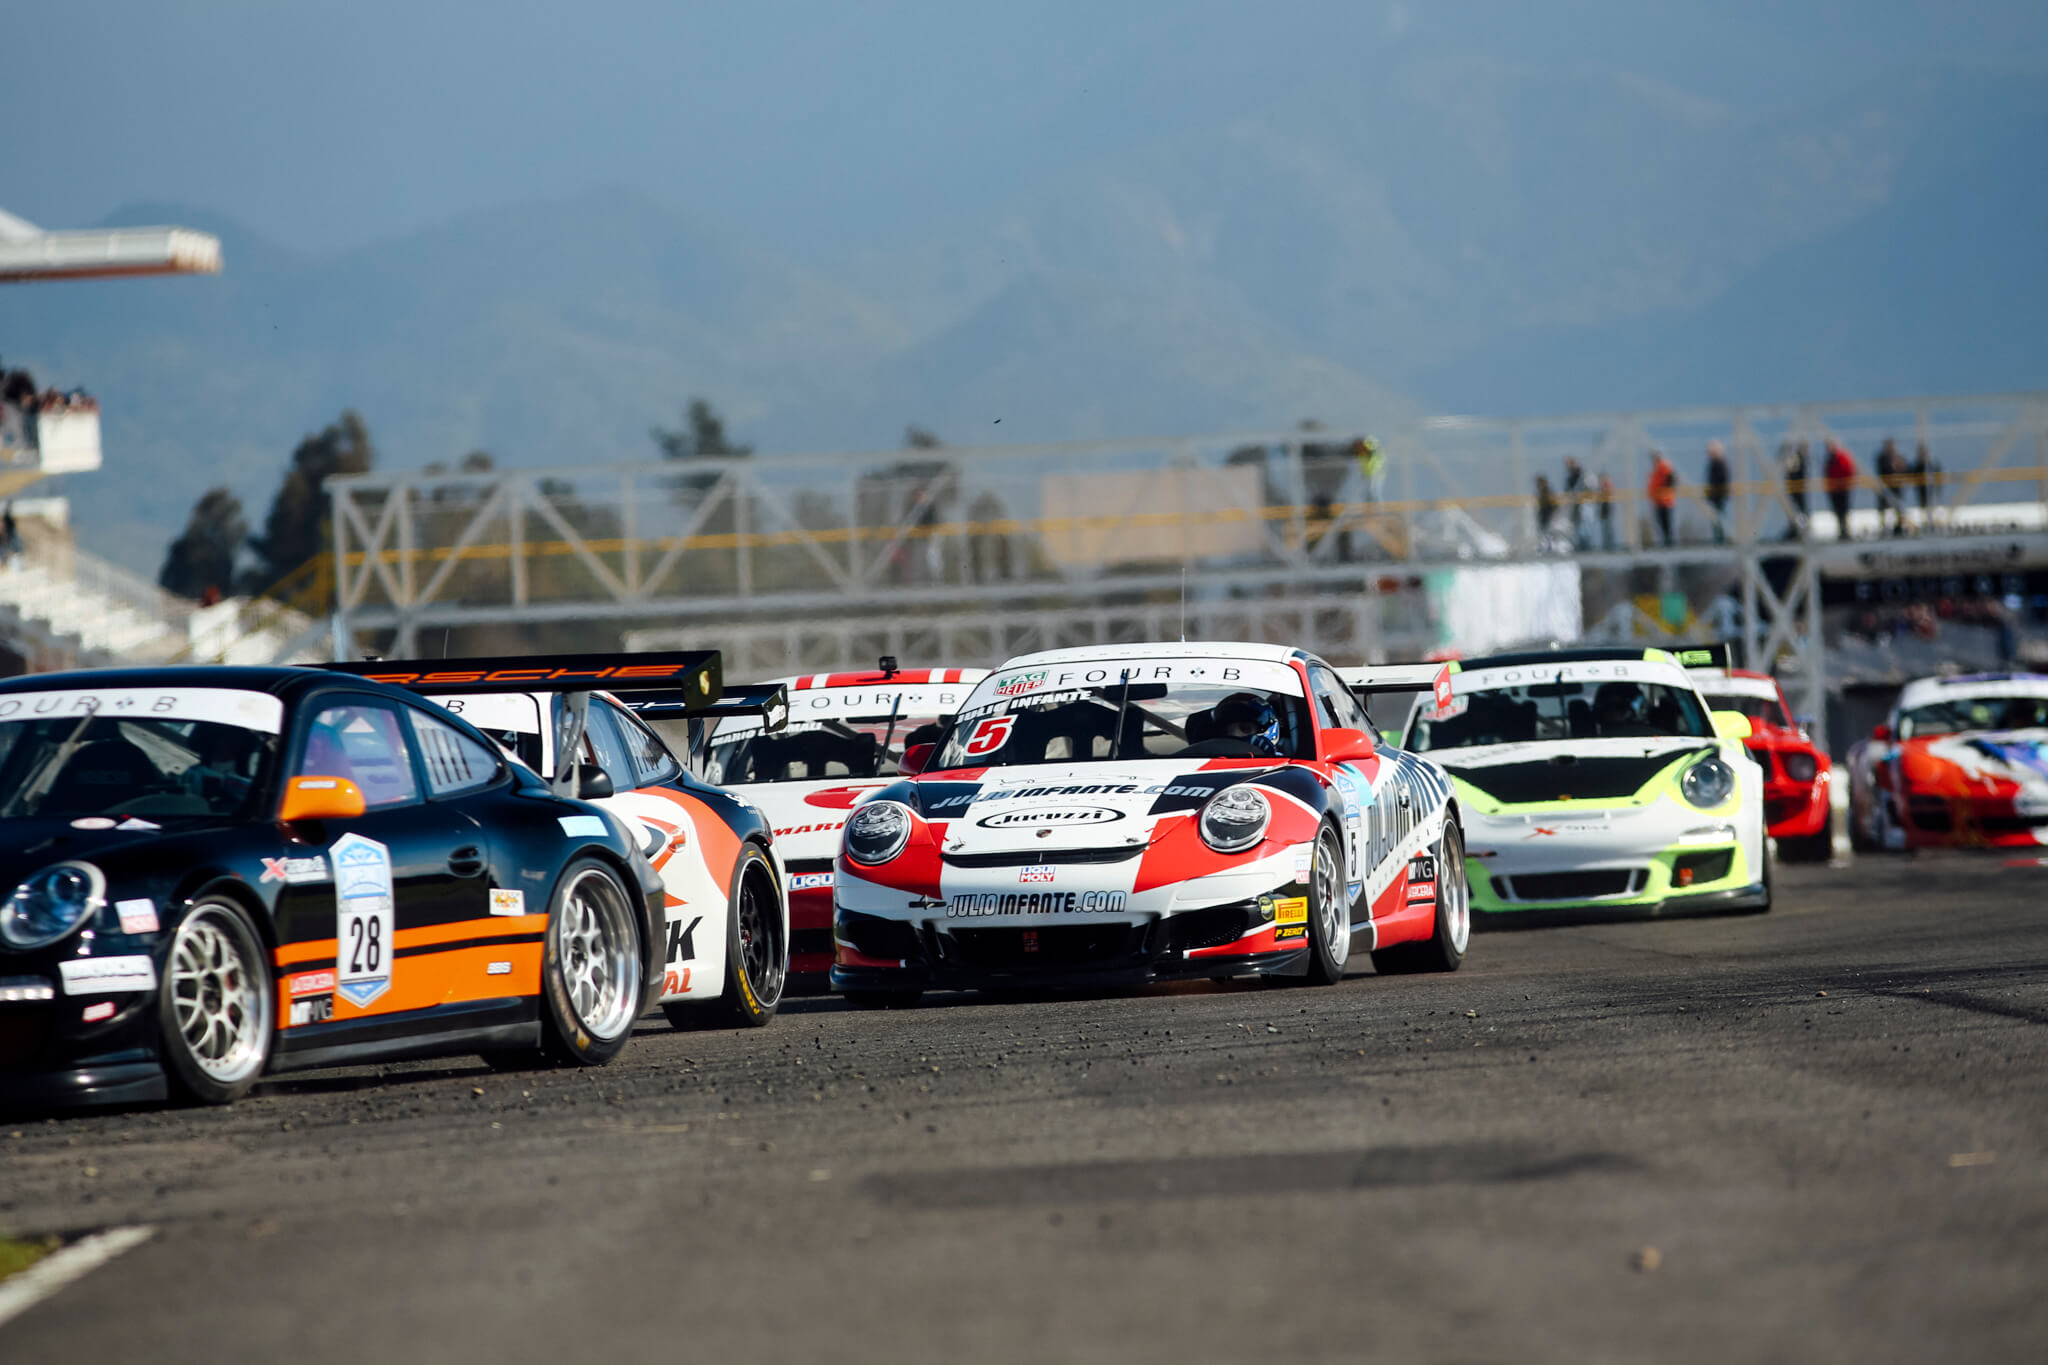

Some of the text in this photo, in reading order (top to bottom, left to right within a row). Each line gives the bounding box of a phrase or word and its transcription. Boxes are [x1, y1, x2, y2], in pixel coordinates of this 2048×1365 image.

[1005, 671, 1045, 686] TAG
[1058, 667, 1241, 685] FOUR B
[1483, 665, 1629, 685] FOUR B
[997, 680, 1044, 696] HEUER
[151, 695, 178, 712] B
[446, 700, 465, 714] B
[940, 693, 955, 704] B
[955, 690, 1093, 724] JULIO INFANTE
[966, 716, 1014, 755] 5
[998, 809, 1104, 825] Jacuzzi
[1351, 832, 1357, 878] 5
[1020, 873, 1055, 882] MOLY
[350, 914, 381, 974] 28
